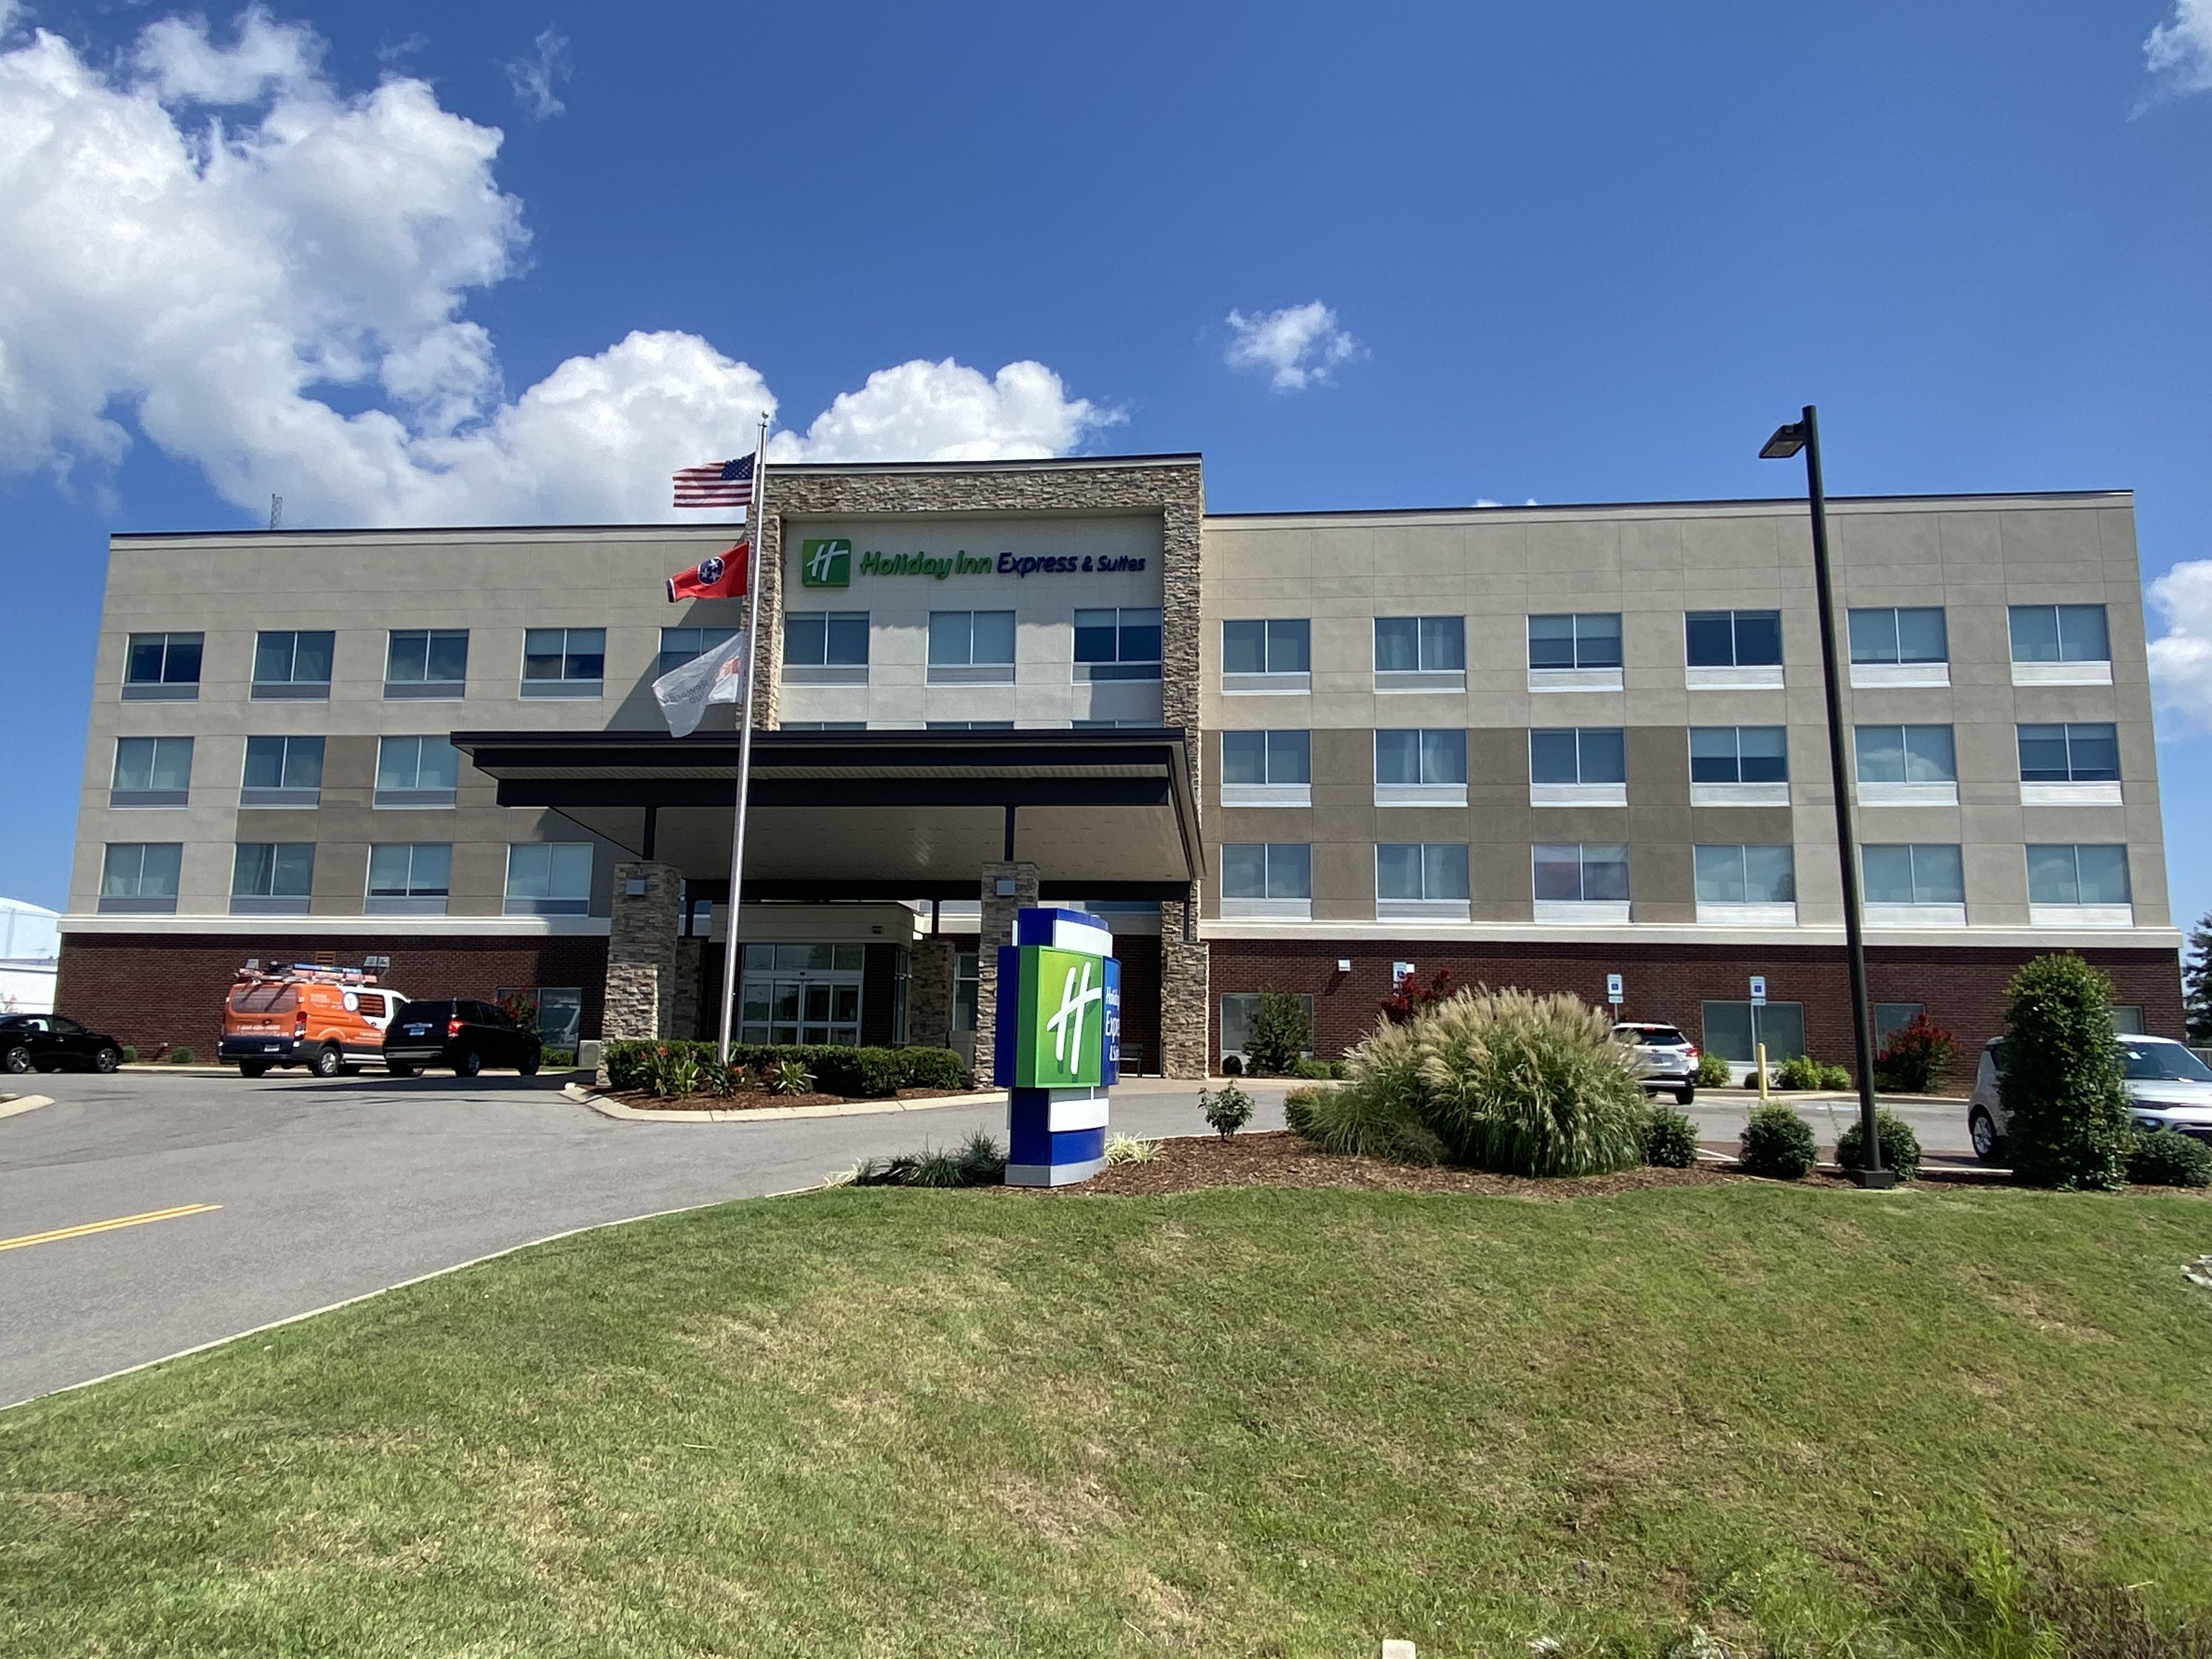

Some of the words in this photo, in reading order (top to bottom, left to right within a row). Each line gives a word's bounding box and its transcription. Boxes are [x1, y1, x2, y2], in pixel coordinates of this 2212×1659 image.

[860, 551, 953, 580] Holiday
[955, 550, 992, 574] Inn
[996, 552, 1078, 578] Express
[1082, 555, 1093, 572] &
[1097, 555, 1146, 572] Suites
